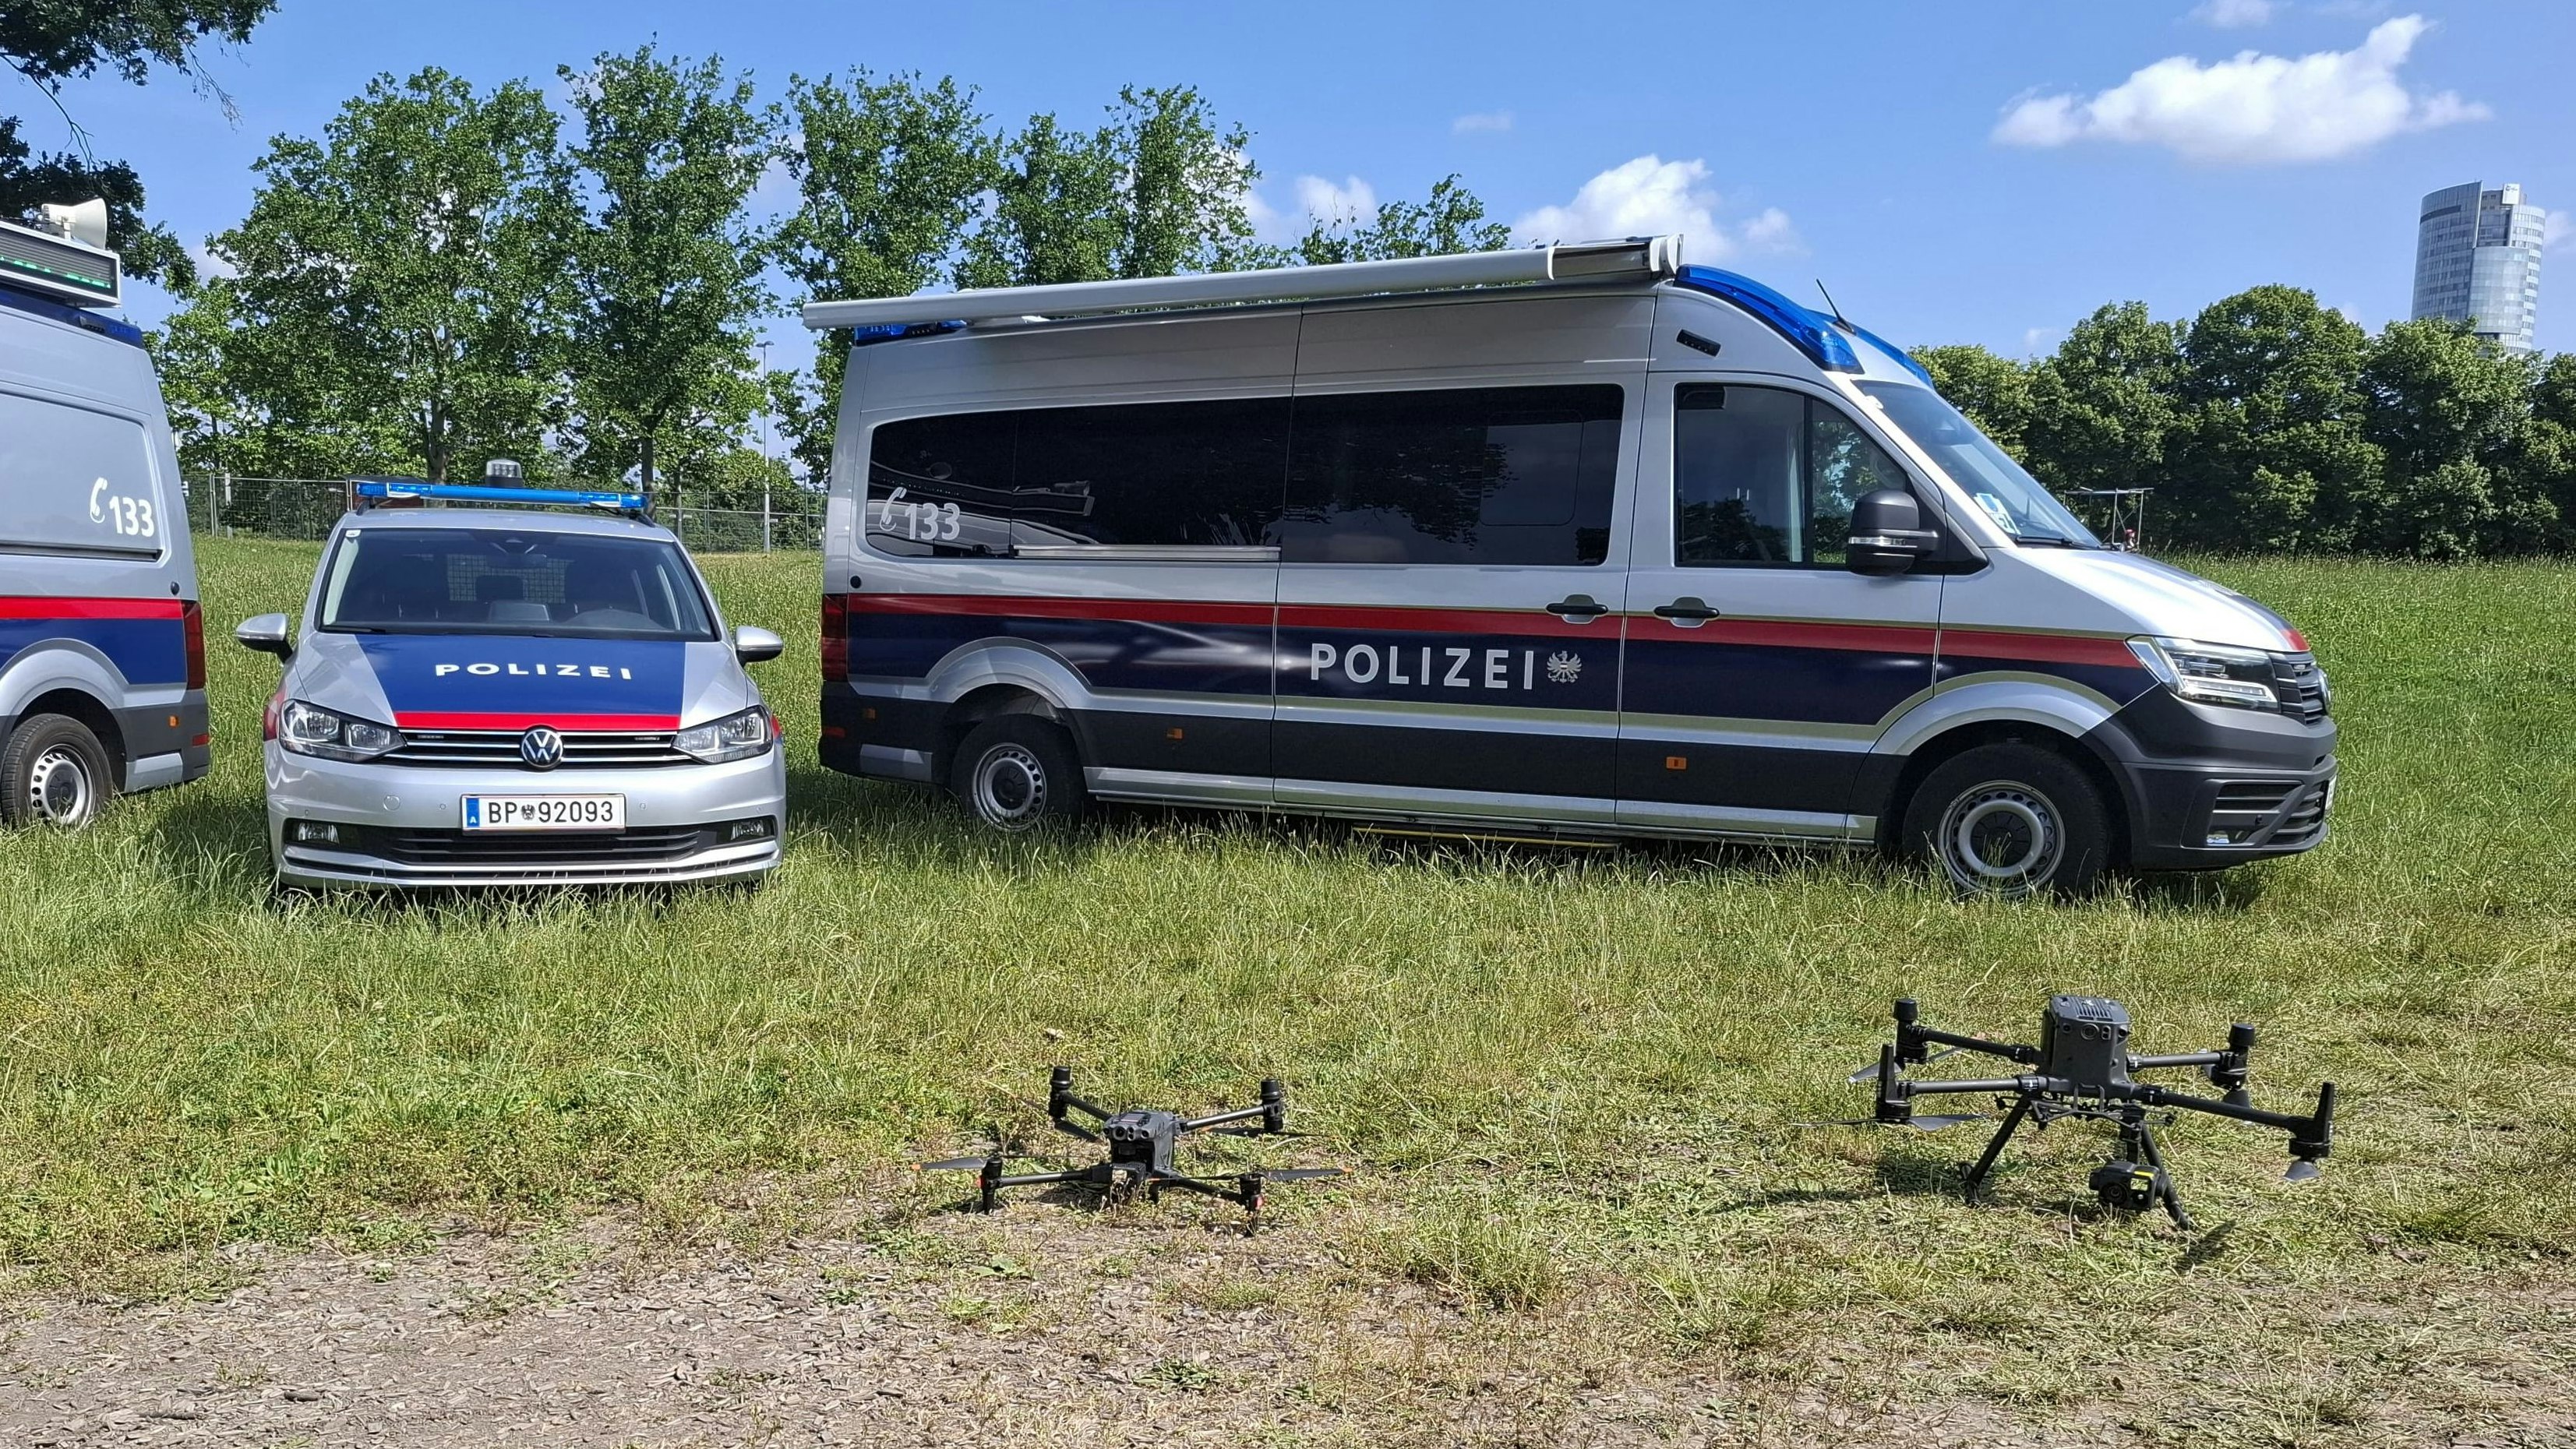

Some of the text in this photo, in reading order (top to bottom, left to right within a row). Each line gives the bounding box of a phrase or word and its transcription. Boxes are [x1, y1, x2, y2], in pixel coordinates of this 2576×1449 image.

[109, 495, 155, 538] 133
[905, 502, 960, 541] 133
[435, 663, 632, 680] POLIZEI
[1311, 643, 1534, 690] POLIZEI
[522, 728, 563, 765] VW
[488, 801, 613, 823] BP 92093
